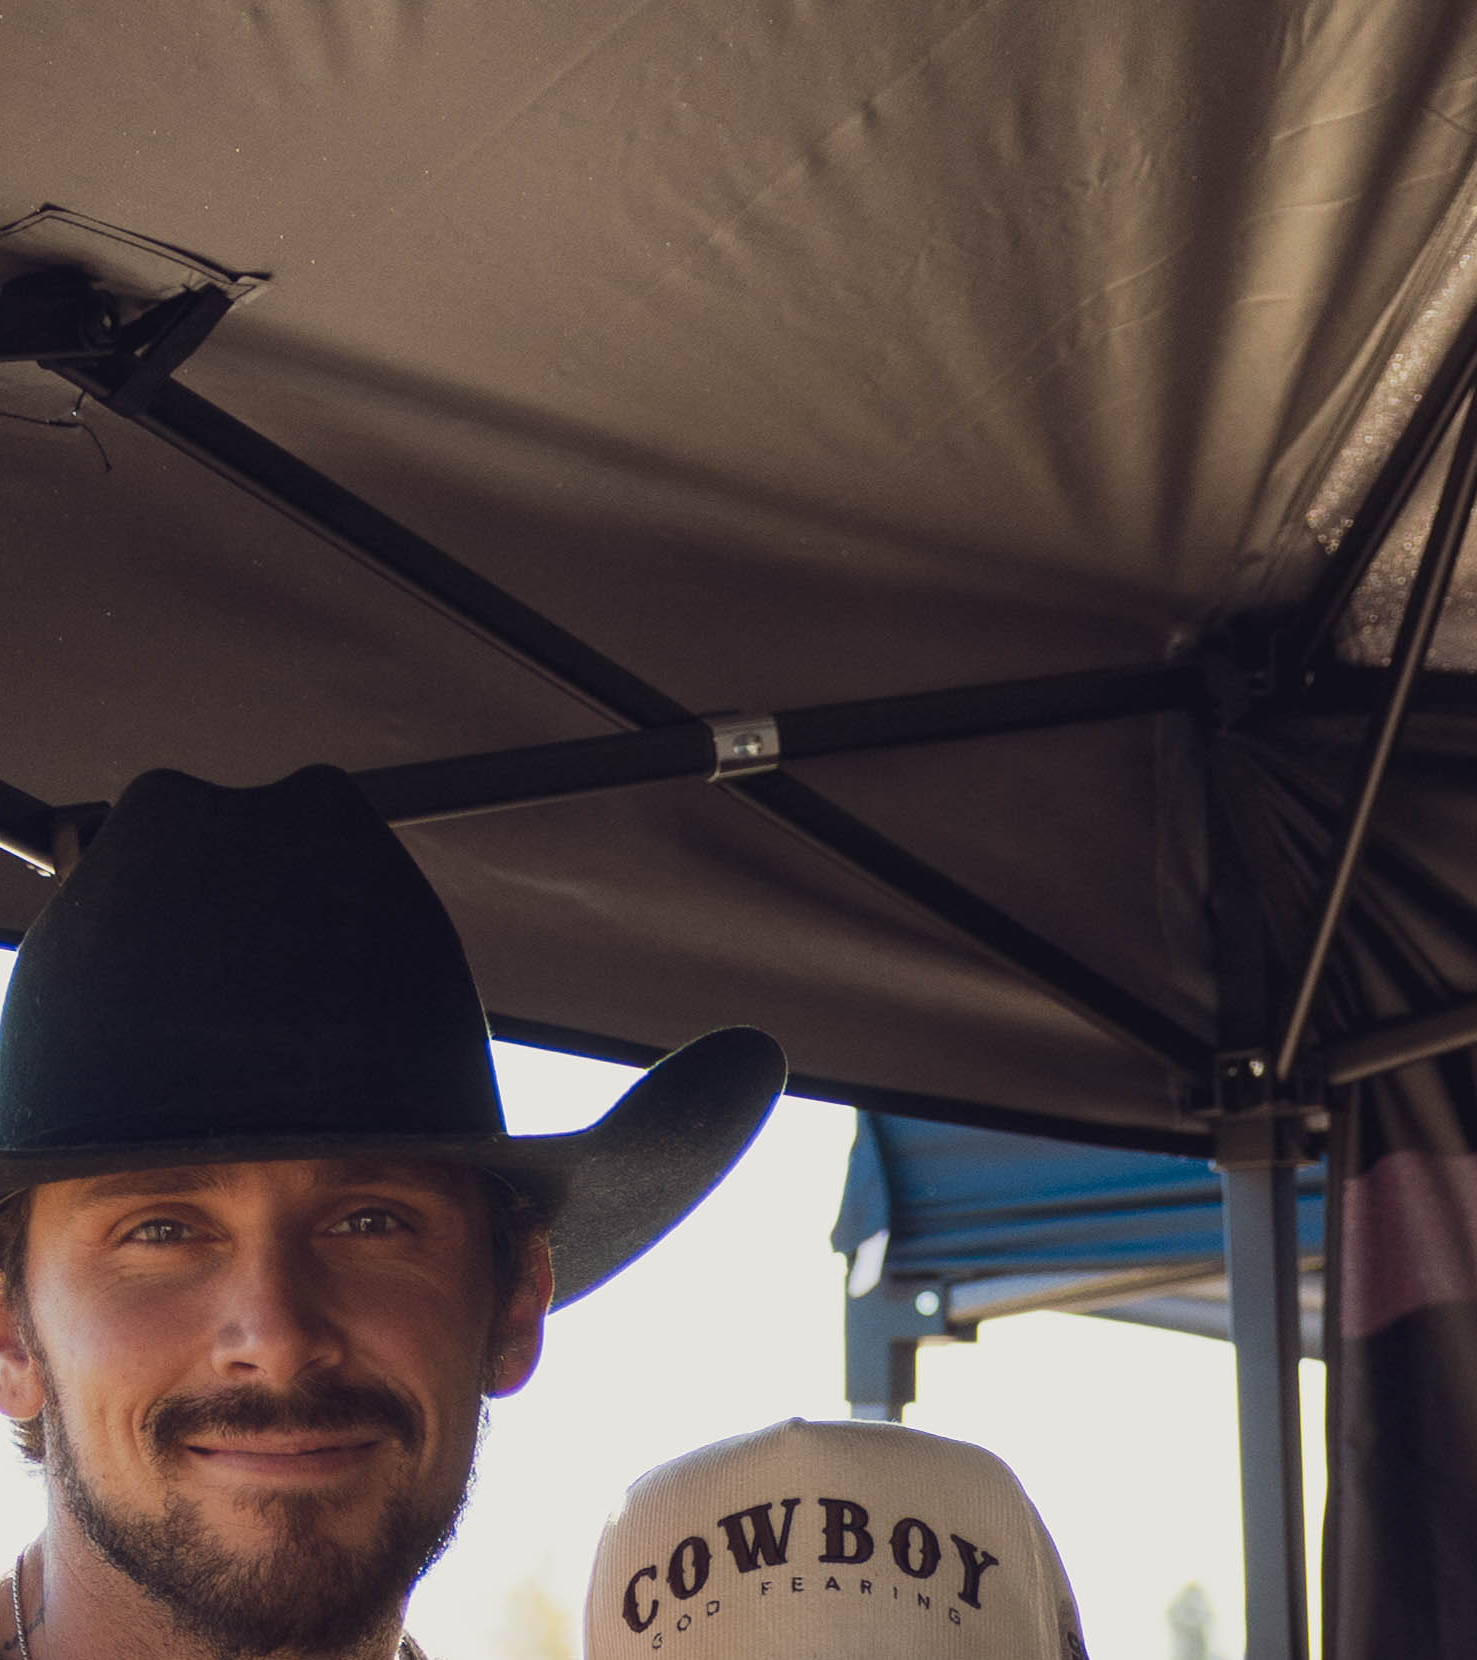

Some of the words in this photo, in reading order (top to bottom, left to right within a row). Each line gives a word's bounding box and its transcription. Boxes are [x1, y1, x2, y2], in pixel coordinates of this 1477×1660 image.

[622, 1498, 999, 1633] COWBOY
[651, 1600, 720, 1649] GOD
[760, 1577, 962, 1625] FEARING
